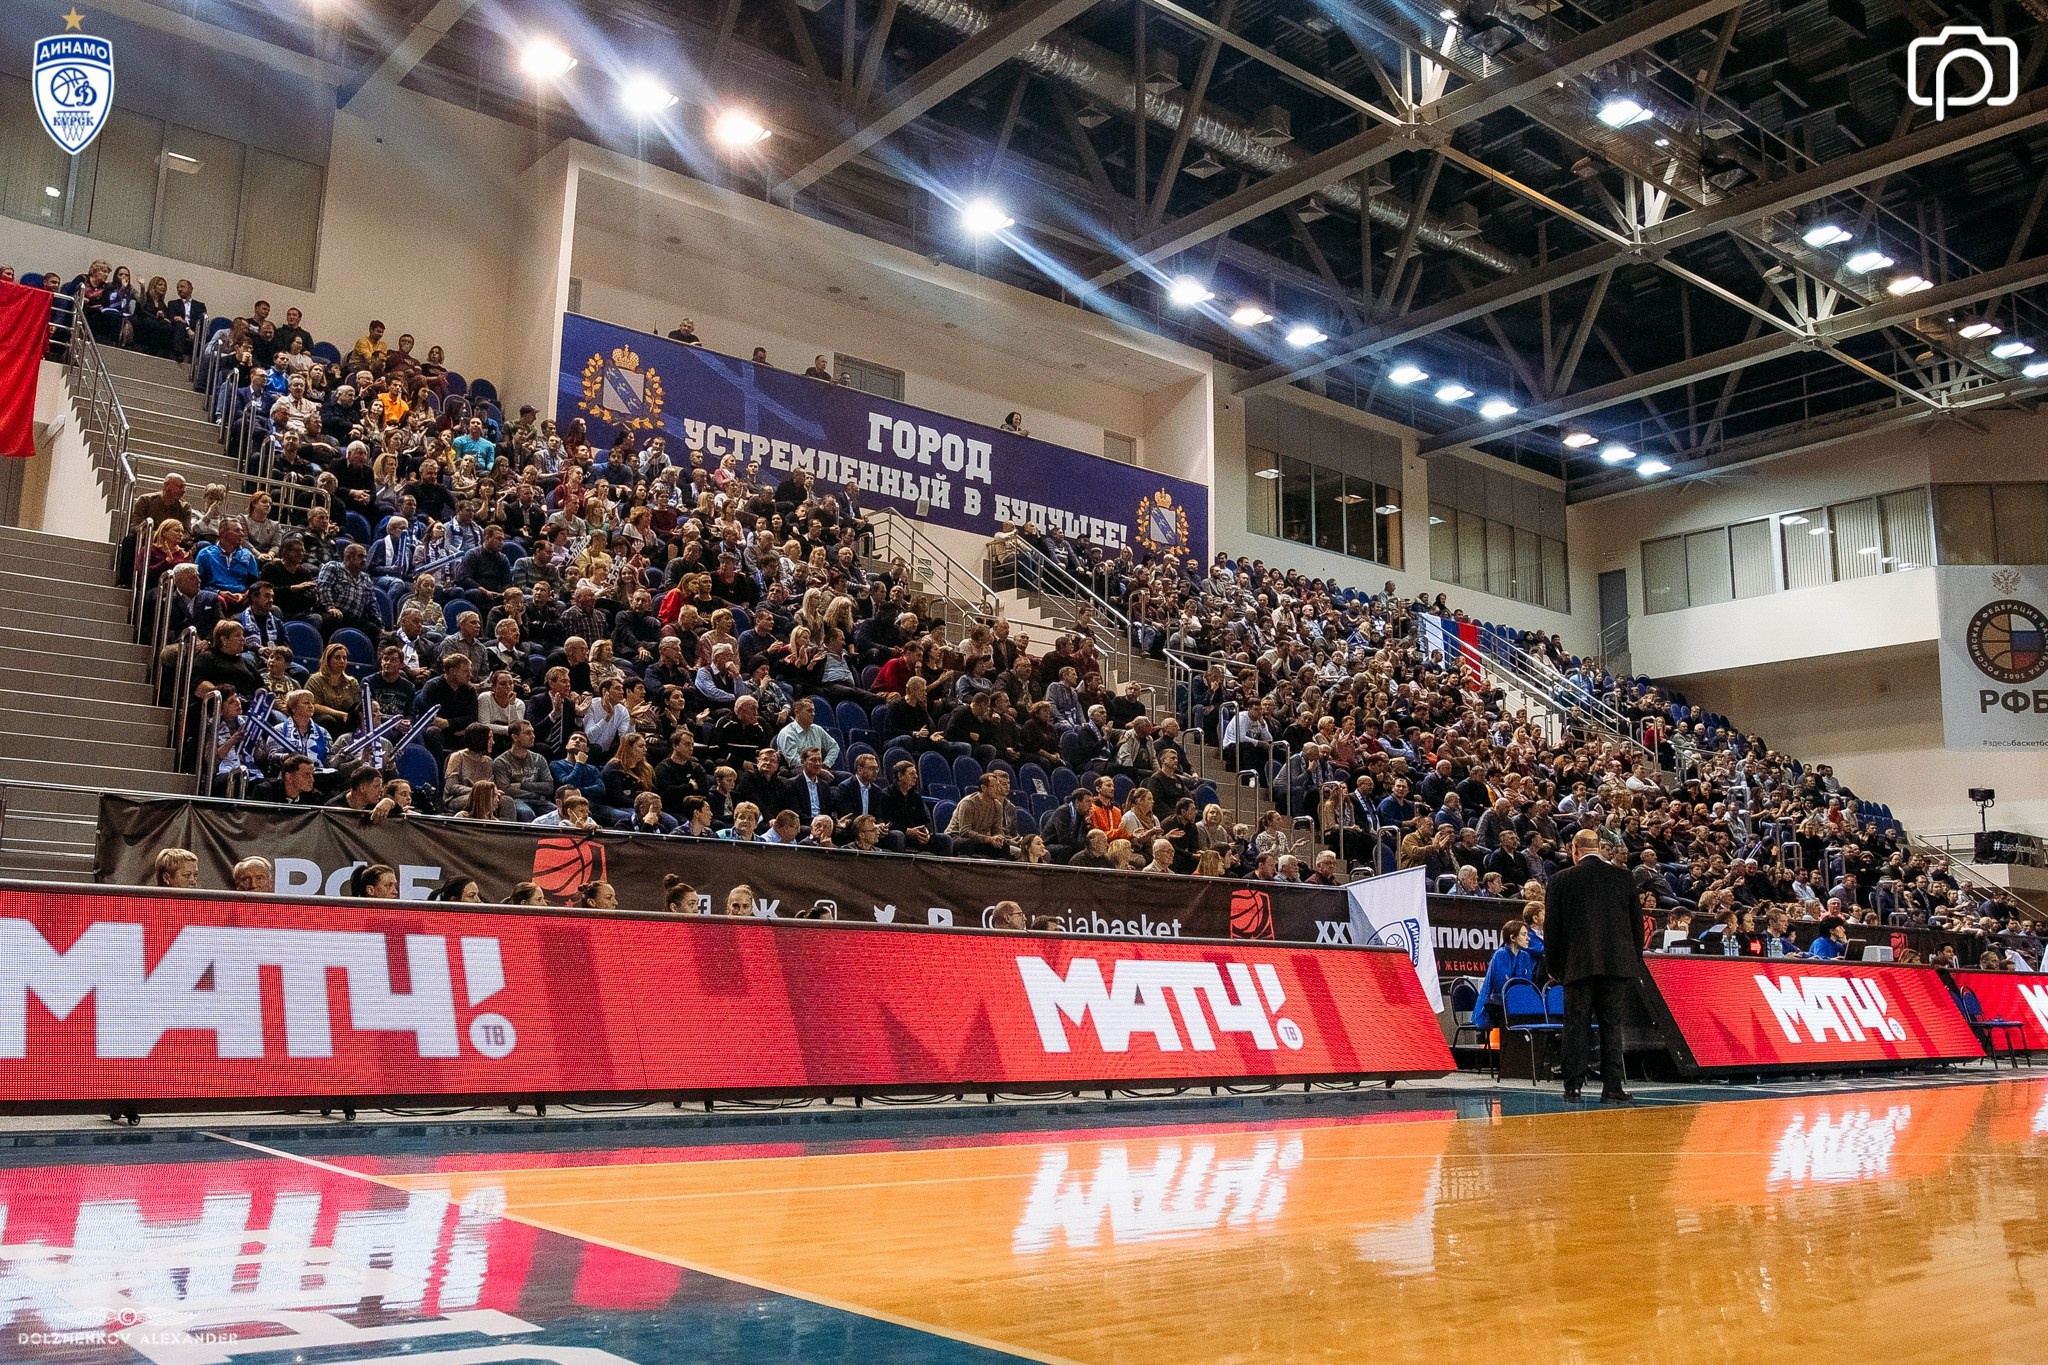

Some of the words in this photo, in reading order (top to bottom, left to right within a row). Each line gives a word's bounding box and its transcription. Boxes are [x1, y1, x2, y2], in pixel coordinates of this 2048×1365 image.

[684, 418, 950, 509] УСТРЕМЛЕННЫЙ
[963, 487, 982, 516] В
[868, 412, 992, 484] ГОРОД
[1983, 604, 2038, 619] ФЕДЕРАЦИЯ
[1971, 620, 1999, 676] РОССИЙСКАЯ
[1979, 689, 2048, 714] РФБ
[1444, 960, 1490, 972] ЖЕНСКИ
